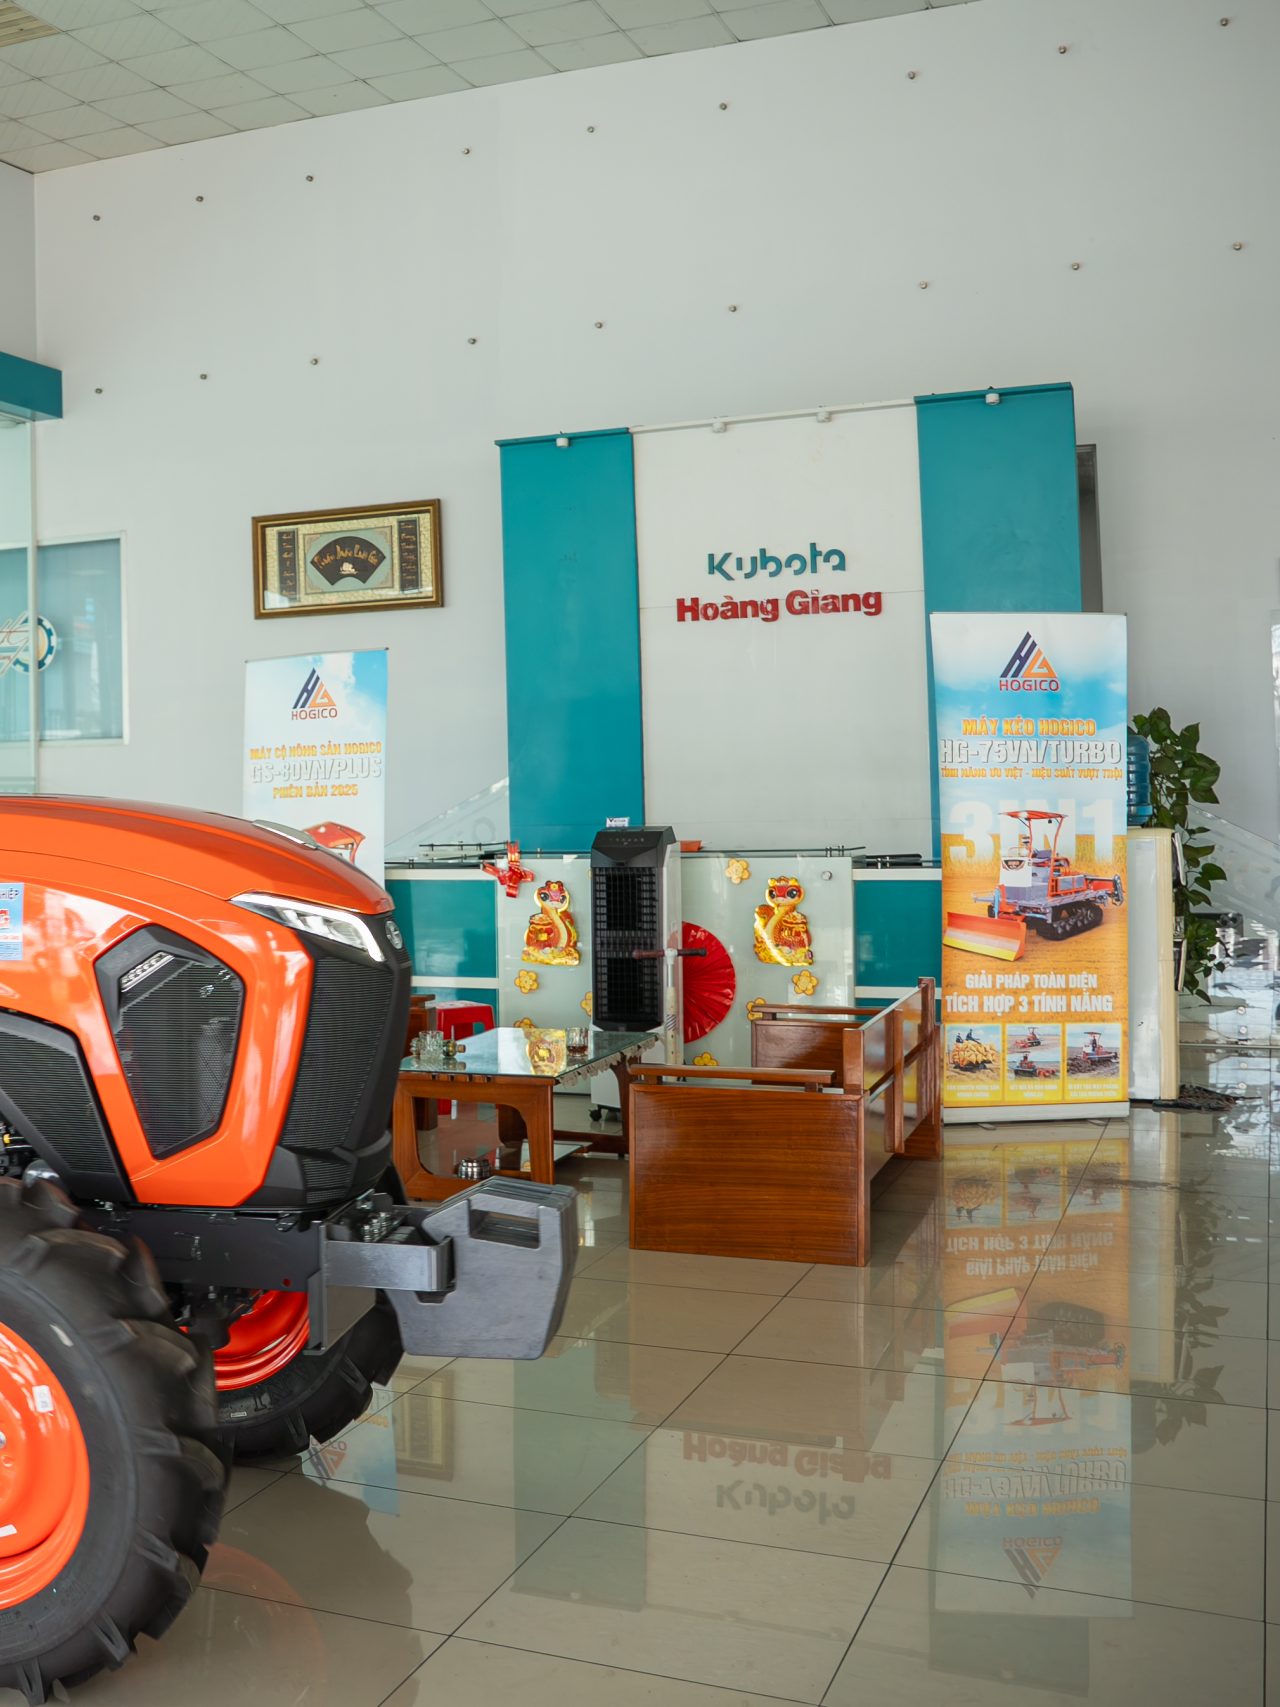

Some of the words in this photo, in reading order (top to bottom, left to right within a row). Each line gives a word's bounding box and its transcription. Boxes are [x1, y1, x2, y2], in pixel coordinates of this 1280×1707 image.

[708, 542, 846, 581] Kubota
[676, 595, 780, 623] Hoàng
[785, 589, 882, 616] Giang
[999, 679, 1060, 691] HOGICO
[291, 708, 338, 721] HOGICO
[962, 716, 999, 736] MÁY
[1003, 716, 1035, 736] KÉO
[1039, 719, 1096, 736] HOGICO
[249, 745, 272, 760] MÁY
[289, 743, 318, 758] NÔNG
[320, 740, 340, 756] SẢN
[344, 742, 382, 755] HOGICO
[940, 738, 1122, 765] HG-75VN/TURBO
[251, 757, 382, 784] GS-80VN/PLUS
[273, 785, 303, 799] PHIÊN
[331, 783, 359, 797] 2025
[965, 969, 993, 989] GIẢI
[996, 971, 1030, 989] PHÁP
[1034, 970, 1065, 989] TOÀN
[1068, 972, 1098, 992] DIỆN
[945, 992, 979, 1013] TÍCH
[983, 994, 1016, 1016] HỢP
[1018, 996, 1029, 1012] 3
[1032, 992, 1067, 1013] TÍNH
[1071, 991, 1113, 1012] NĂNG
